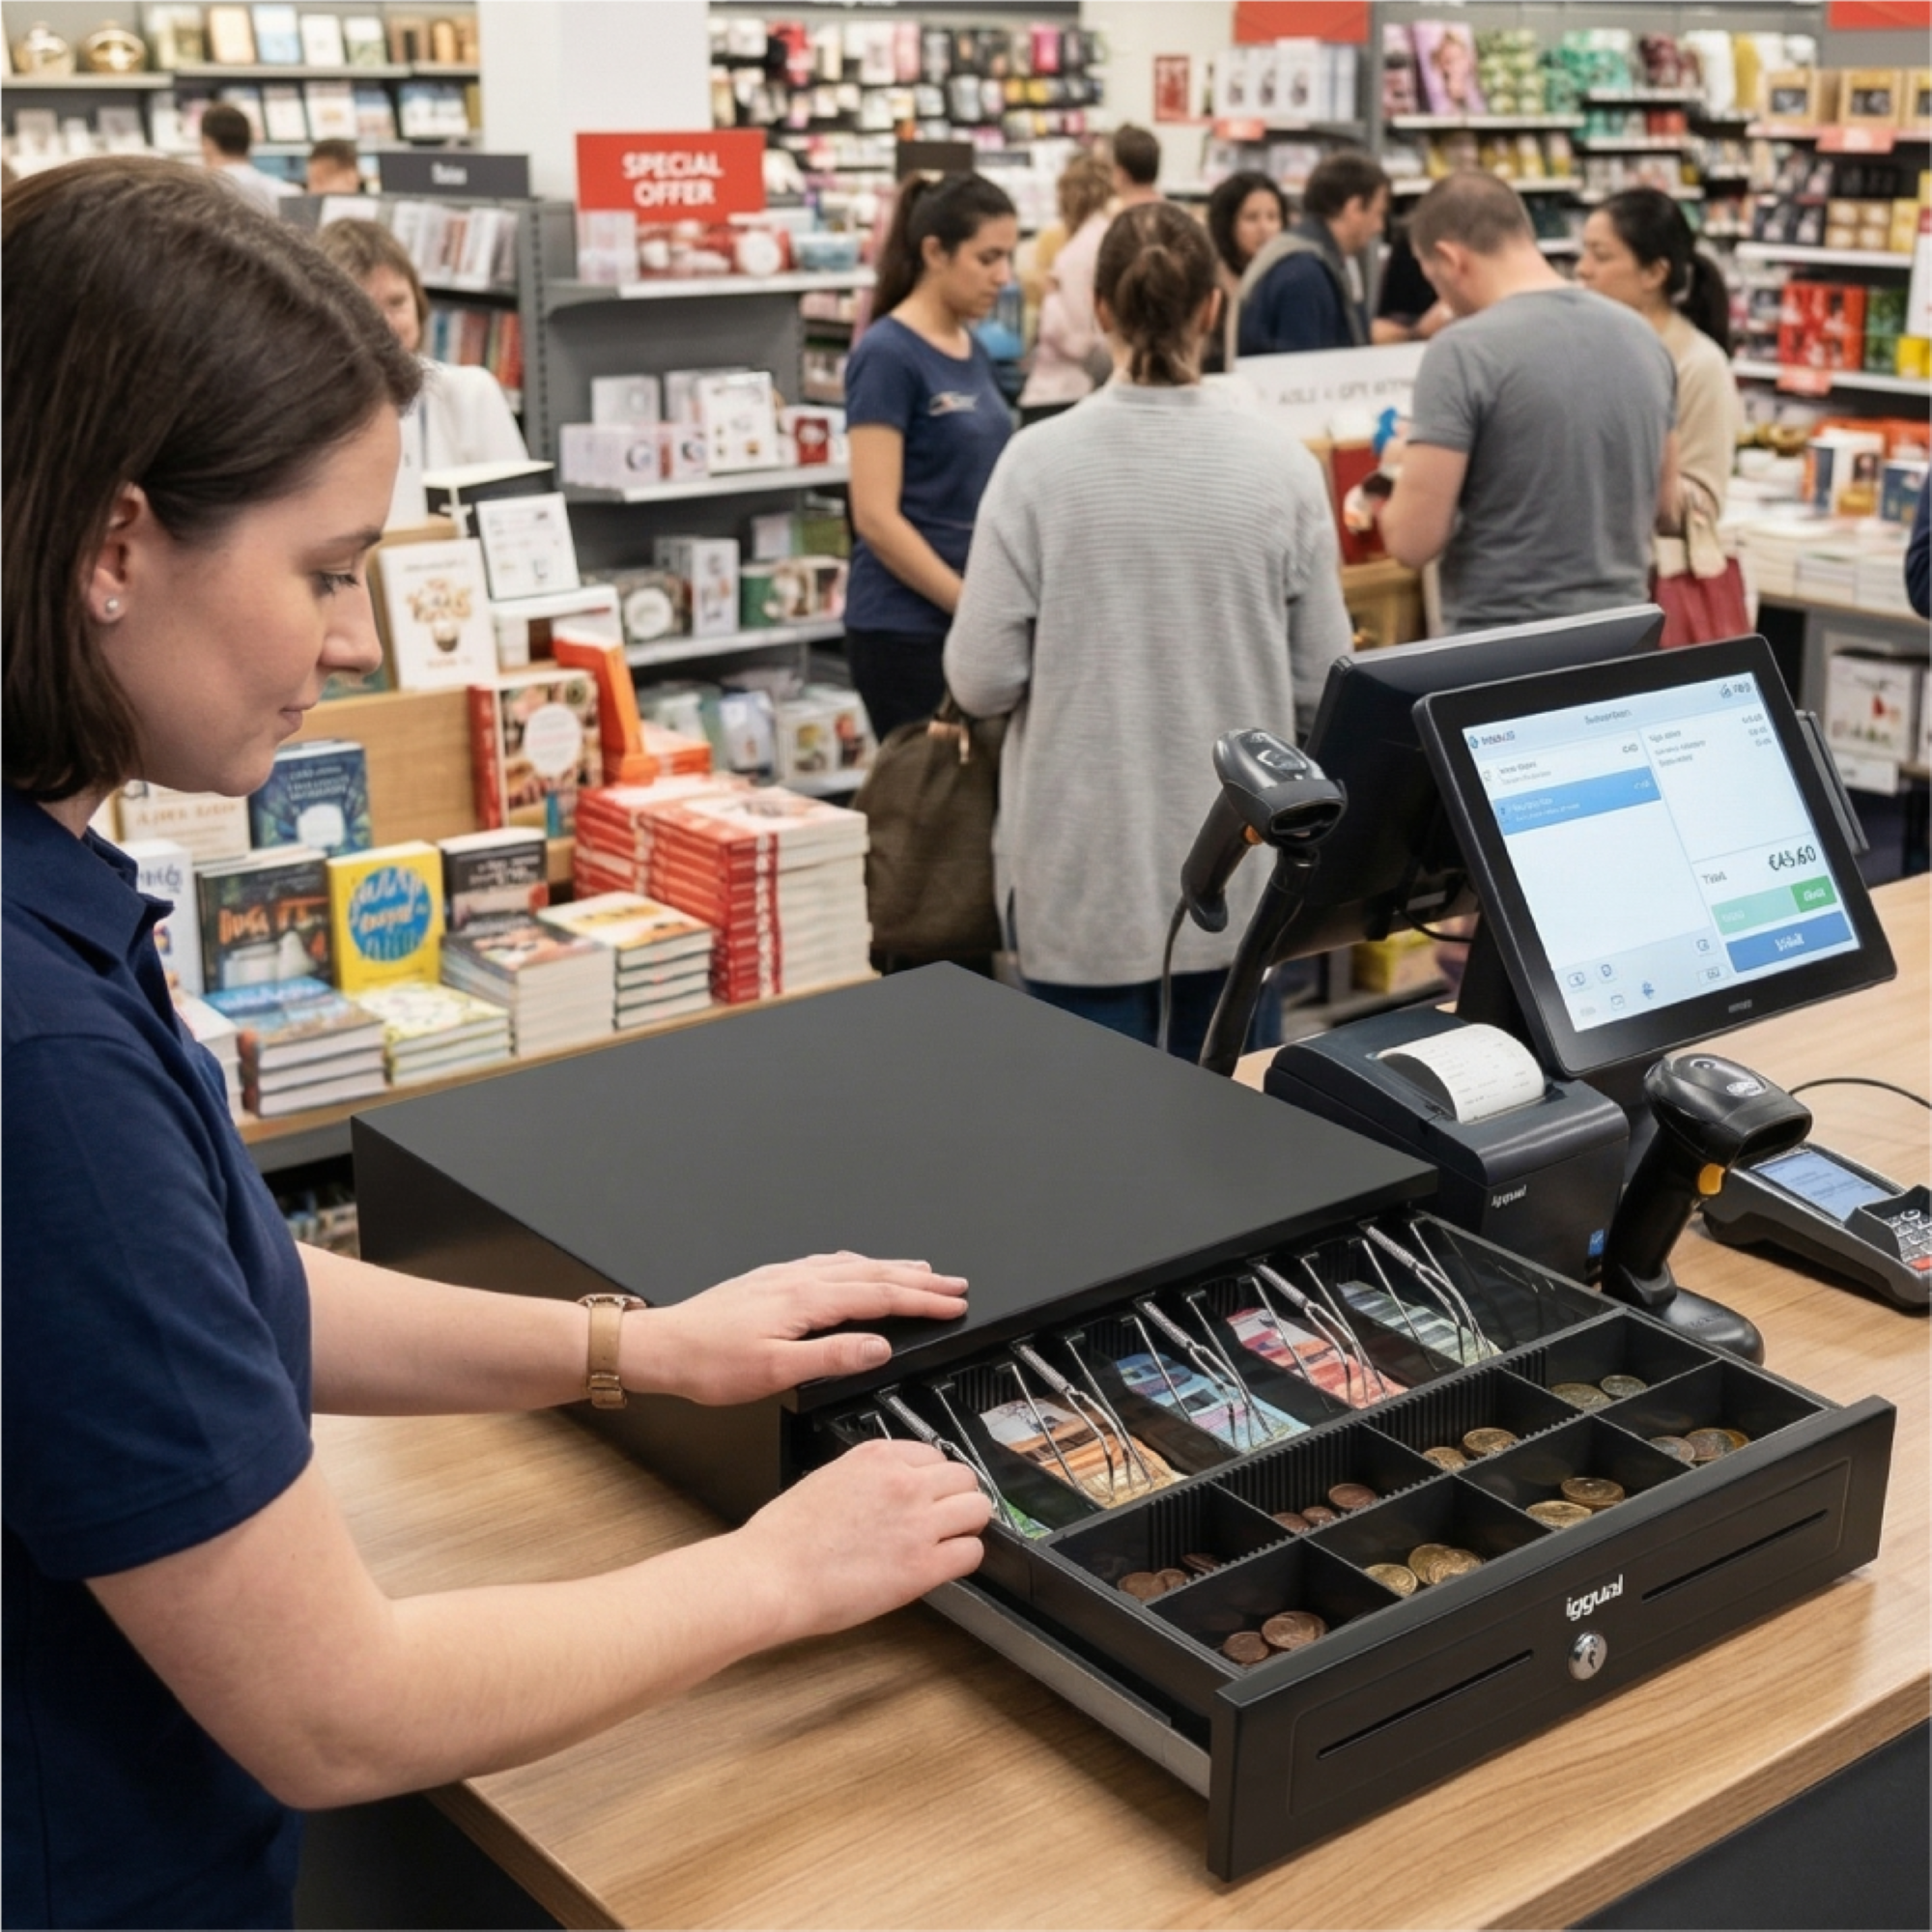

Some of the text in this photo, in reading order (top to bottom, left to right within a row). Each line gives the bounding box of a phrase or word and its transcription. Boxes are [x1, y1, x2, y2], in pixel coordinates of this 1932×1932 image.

[622, 151, 724, 179] SPECIAL
[634, 180, 716, 207] OFFER
[1566, 1574, 1623, 1621] iggual
